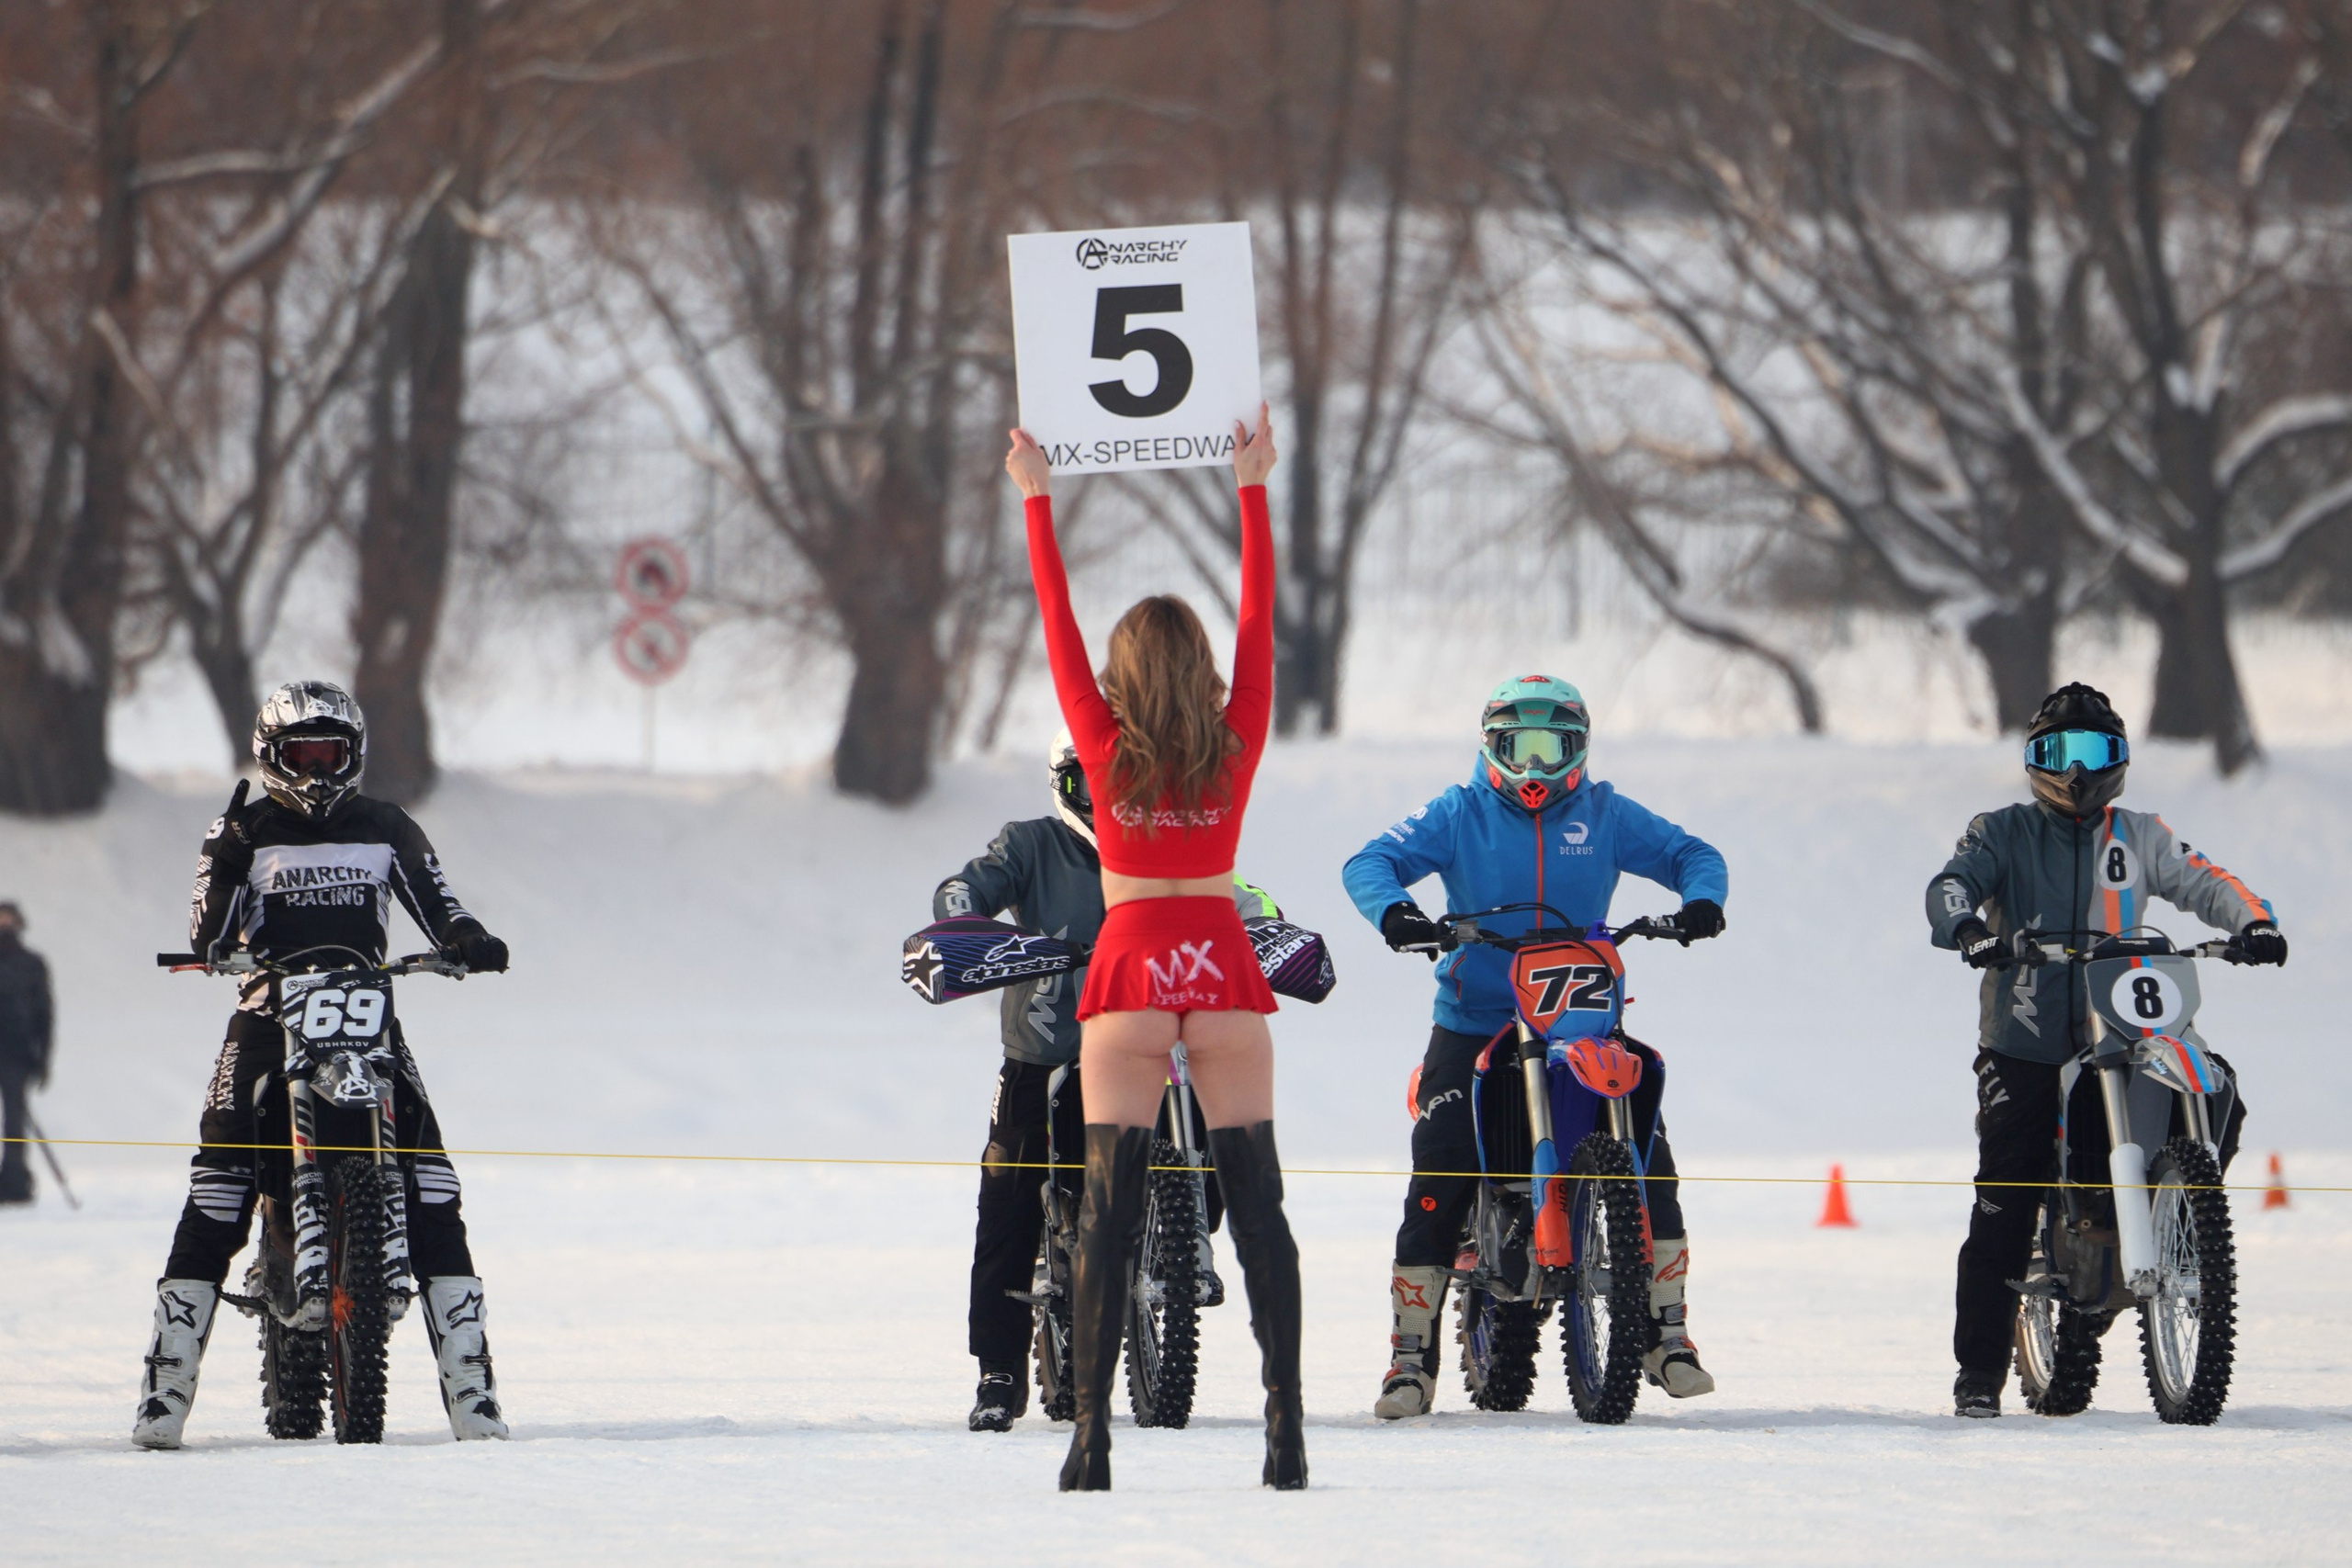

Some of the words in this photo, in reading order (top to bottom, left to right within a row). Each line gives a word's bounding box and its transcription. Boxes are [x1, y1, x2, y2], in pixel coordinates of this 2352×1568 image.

[1110, 252, 1179, 265] RACING
[1088, 283, 1194, 418] 5
[1039, 434, 1257, 467] MX-SPEEDWA
[1559, 846, 1594, 855] DELRUS
[2107, 847, 2127, 883] 8
[272, 866, 371, 890] ANARCHY
[285, 886, 366, 908] RACING
[1968, 936, 2000, 956] LEATT
[2251, 928, 2280, 938] LEATT
[962, 954, 1071, 985] alpinestars
[1145, 940, 1225, 996] MX
[1529, 964, 1617, 1017] 72
[2132, 976, 2164, 1019] 8
[301, 988, 386, 1040] 69
[1979, 1059, 2011, 1108] FLY
